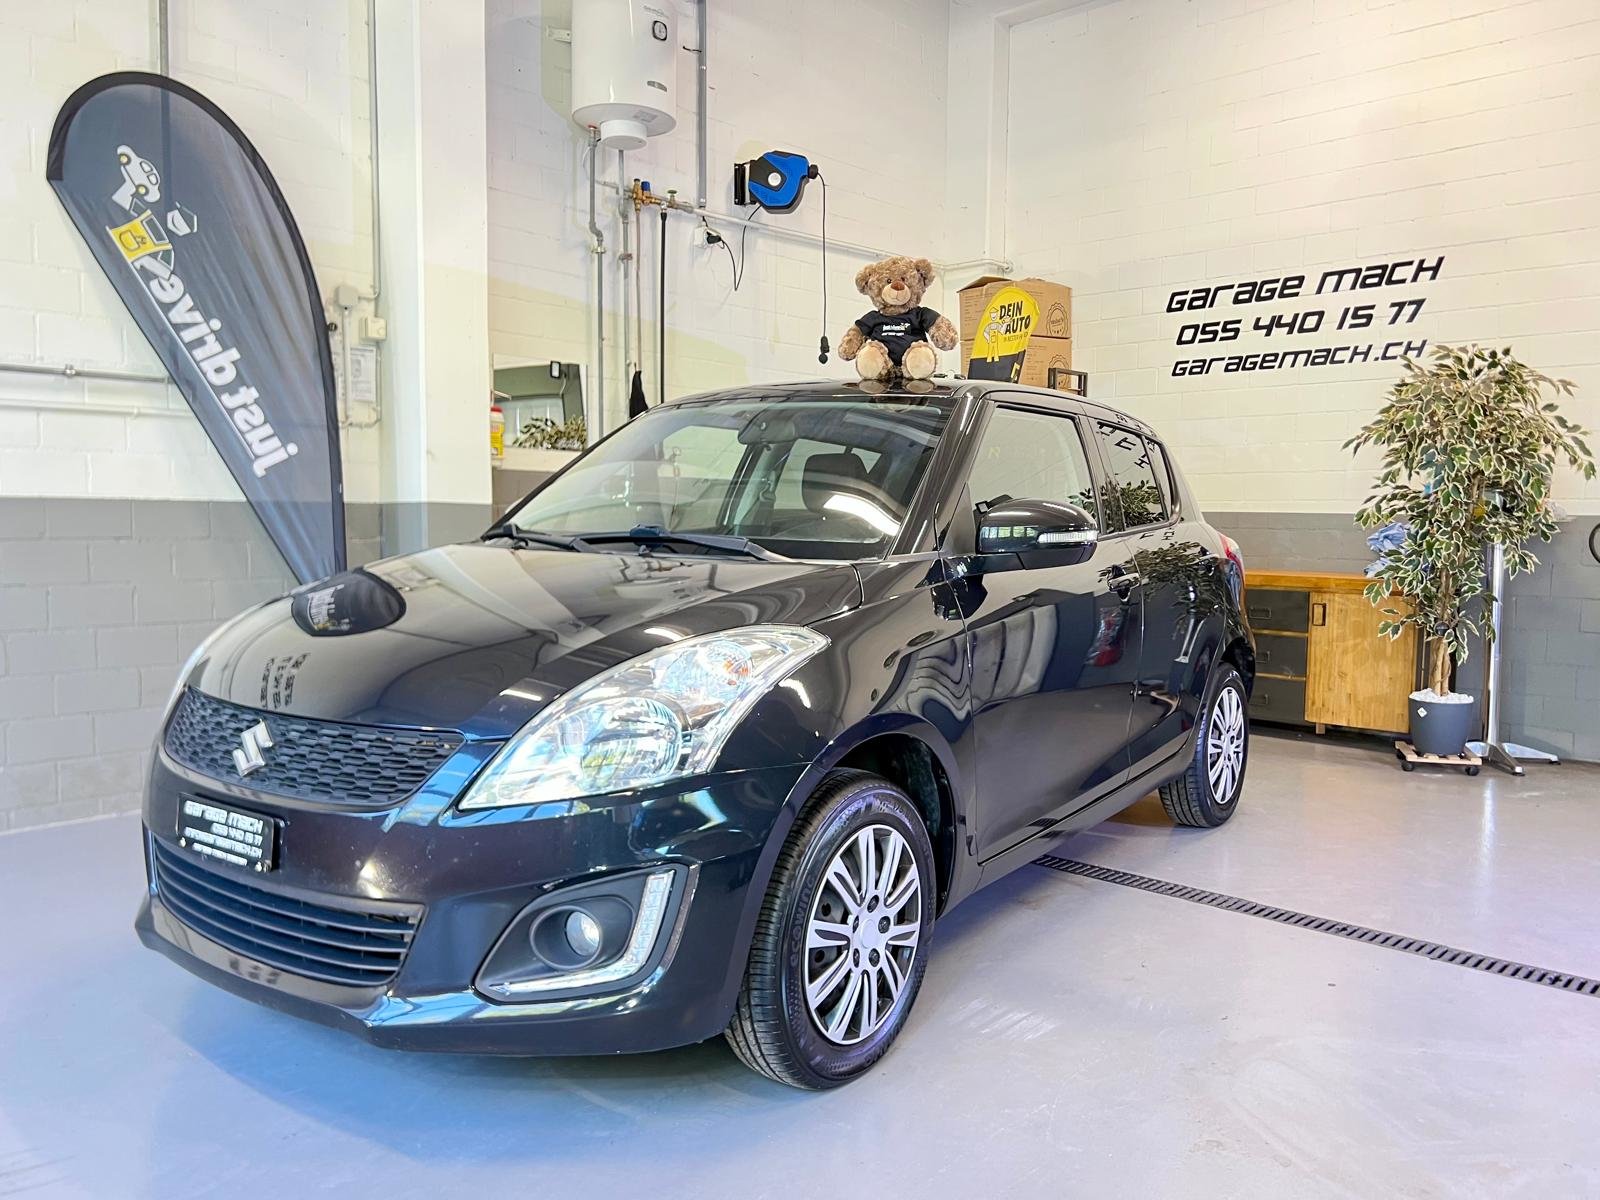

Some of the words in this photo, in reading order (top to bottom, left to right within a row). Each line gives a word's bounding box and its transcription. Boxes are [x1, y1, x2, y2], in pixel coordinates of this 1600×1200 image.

[999, 300, 1024, 319] DEIN
[1005, 314, 1031, 335] AUTO
[1176, 318, 1243, 346] 055
[1253, 310, 1326, 337] 440
[1336, 304, 1376, 331] 15
[1387, 297, 1428, 325] 77
